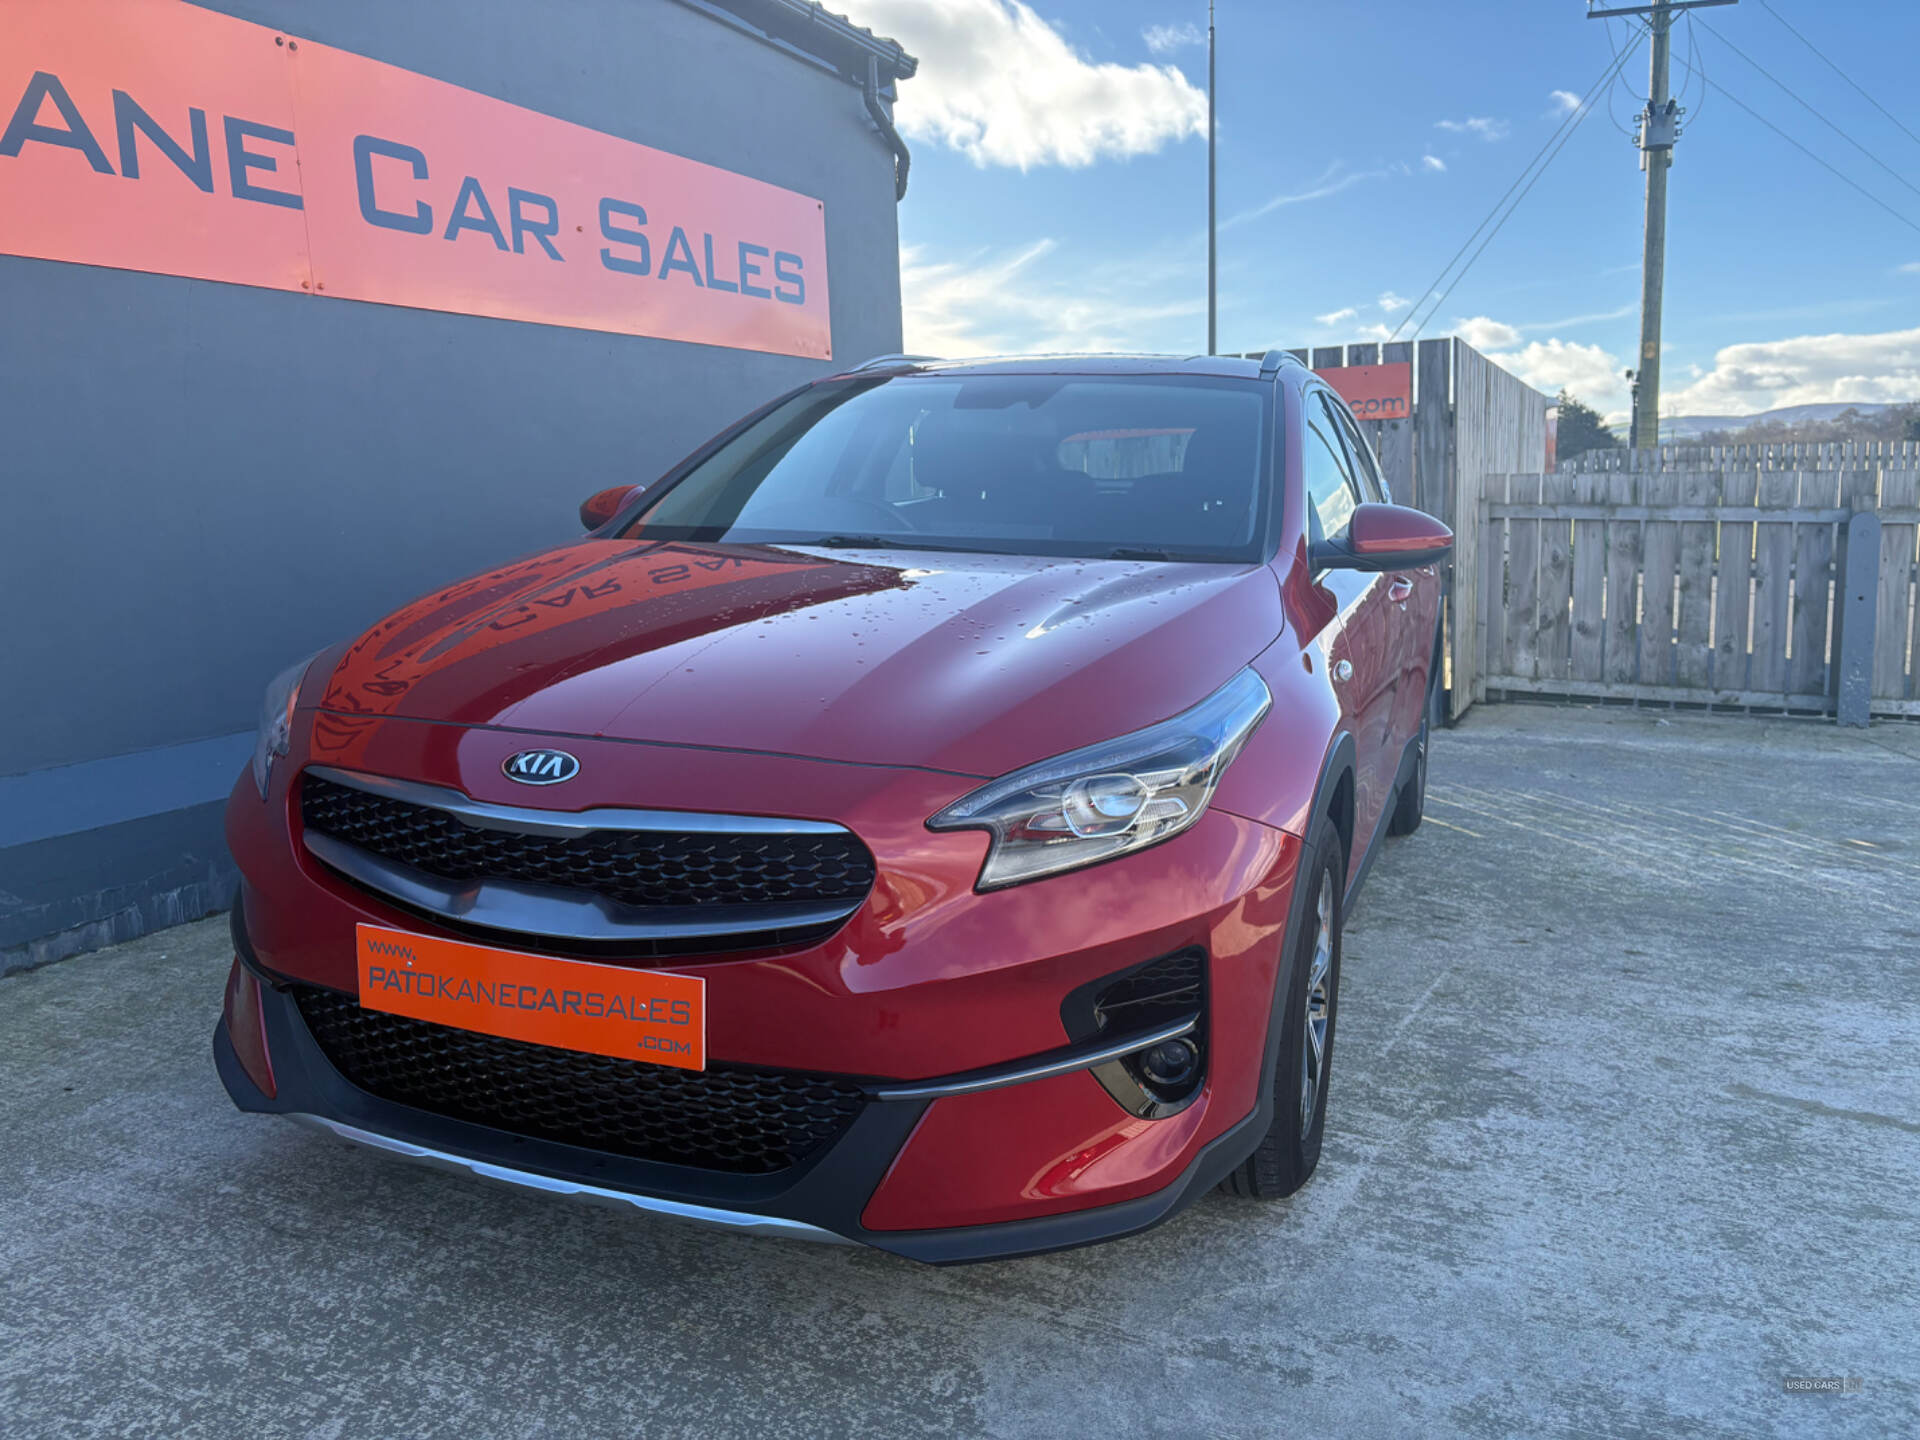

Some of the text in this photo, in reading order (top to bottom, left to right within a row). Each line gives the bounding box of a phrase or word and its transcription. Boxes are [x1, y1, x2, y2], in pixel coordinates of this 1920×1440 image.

[353, 134, 566, 262] CAR
[599, 197, 805, 306] SALES
[510, 752, 563, 777] KIA
[368, 966, 691, 1026] PATOKANECARSALES
